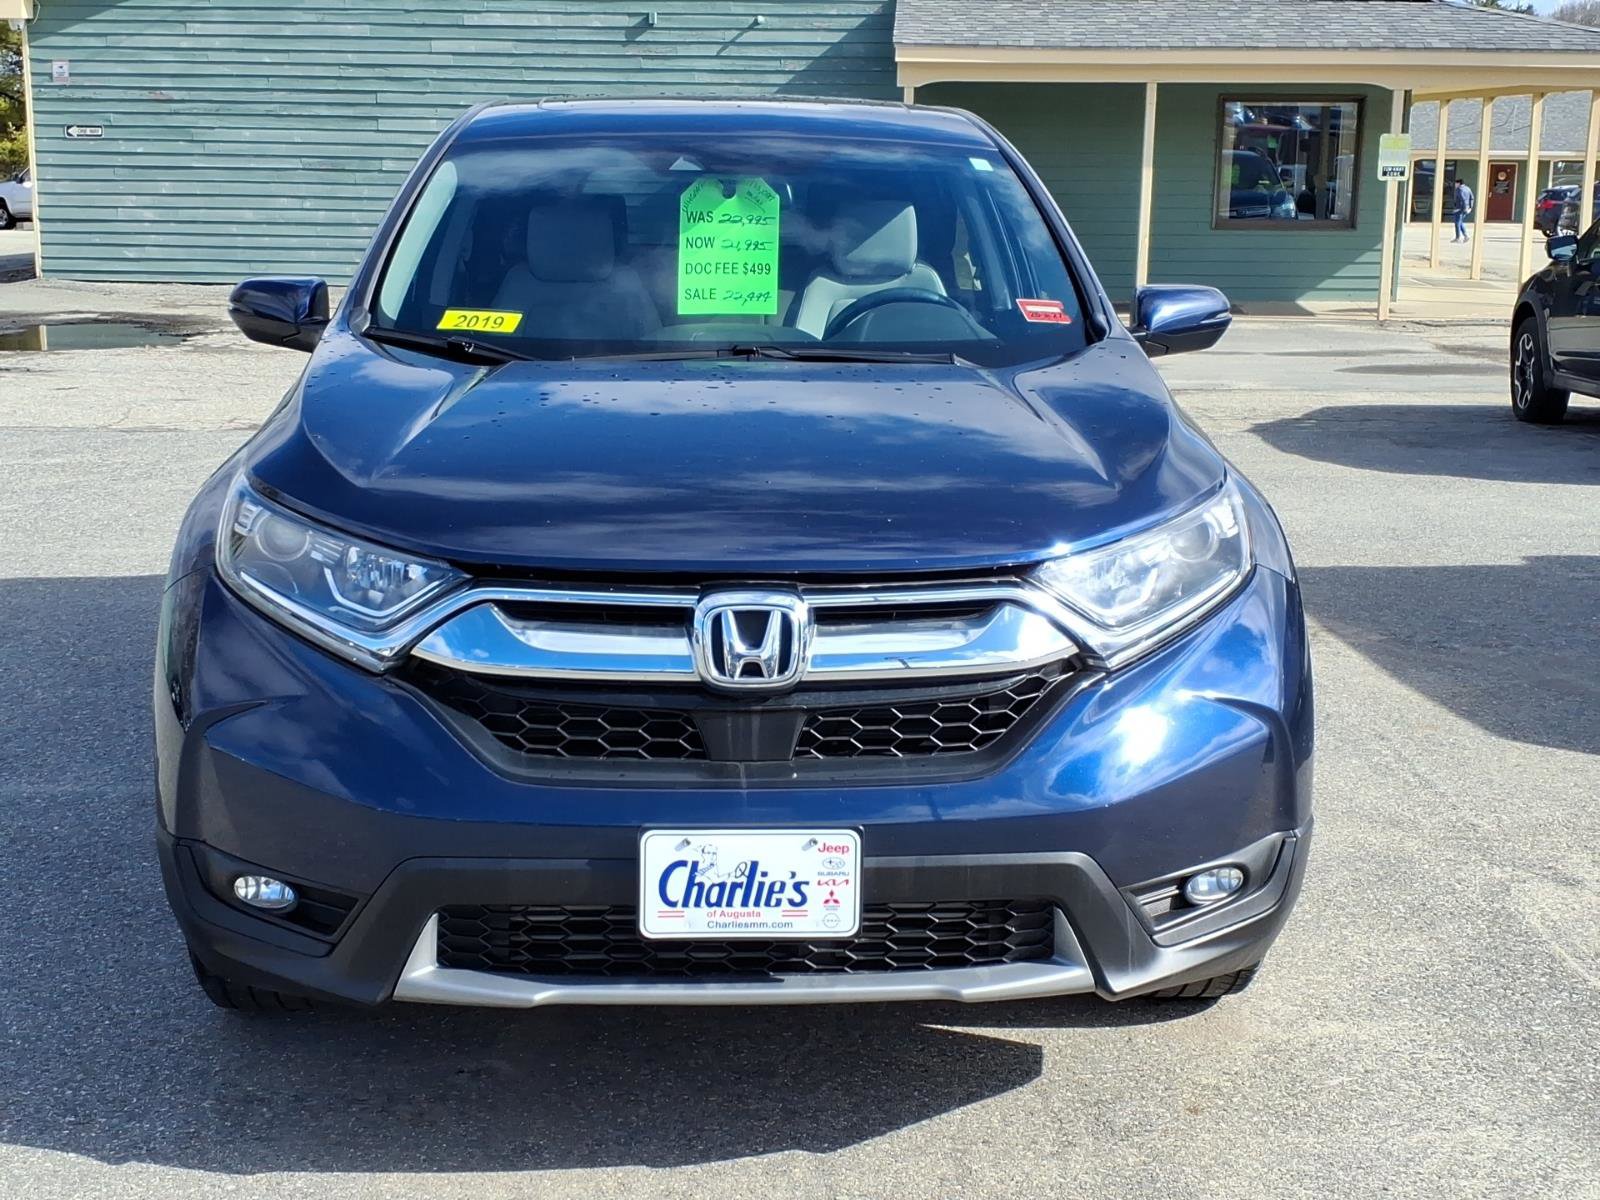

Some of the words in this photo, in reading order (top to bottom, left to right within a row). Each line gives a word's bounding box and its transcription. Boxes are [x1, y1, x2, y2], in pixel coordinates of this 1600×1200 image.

[686, 211, 714, 224] WAS
[718, 213, 776, 227] 22,995
[685, 237, 715, 249] NOW
[685, 262, 712, 275] DOC
[715, 262, 739, 275] FEE
[742, 262, 771, 275] $499
[684, 288, 717, 300] SALE
[453, 314, 505, 329] 2019
[817, 842, 850, 855] Jeep
[658, 859, 810, 909] Charlie's
[706, 909, 717, 918] of
[719, 910, 761, 919] Augusta
[707, 920, 793, 930] Charliesmm.com
